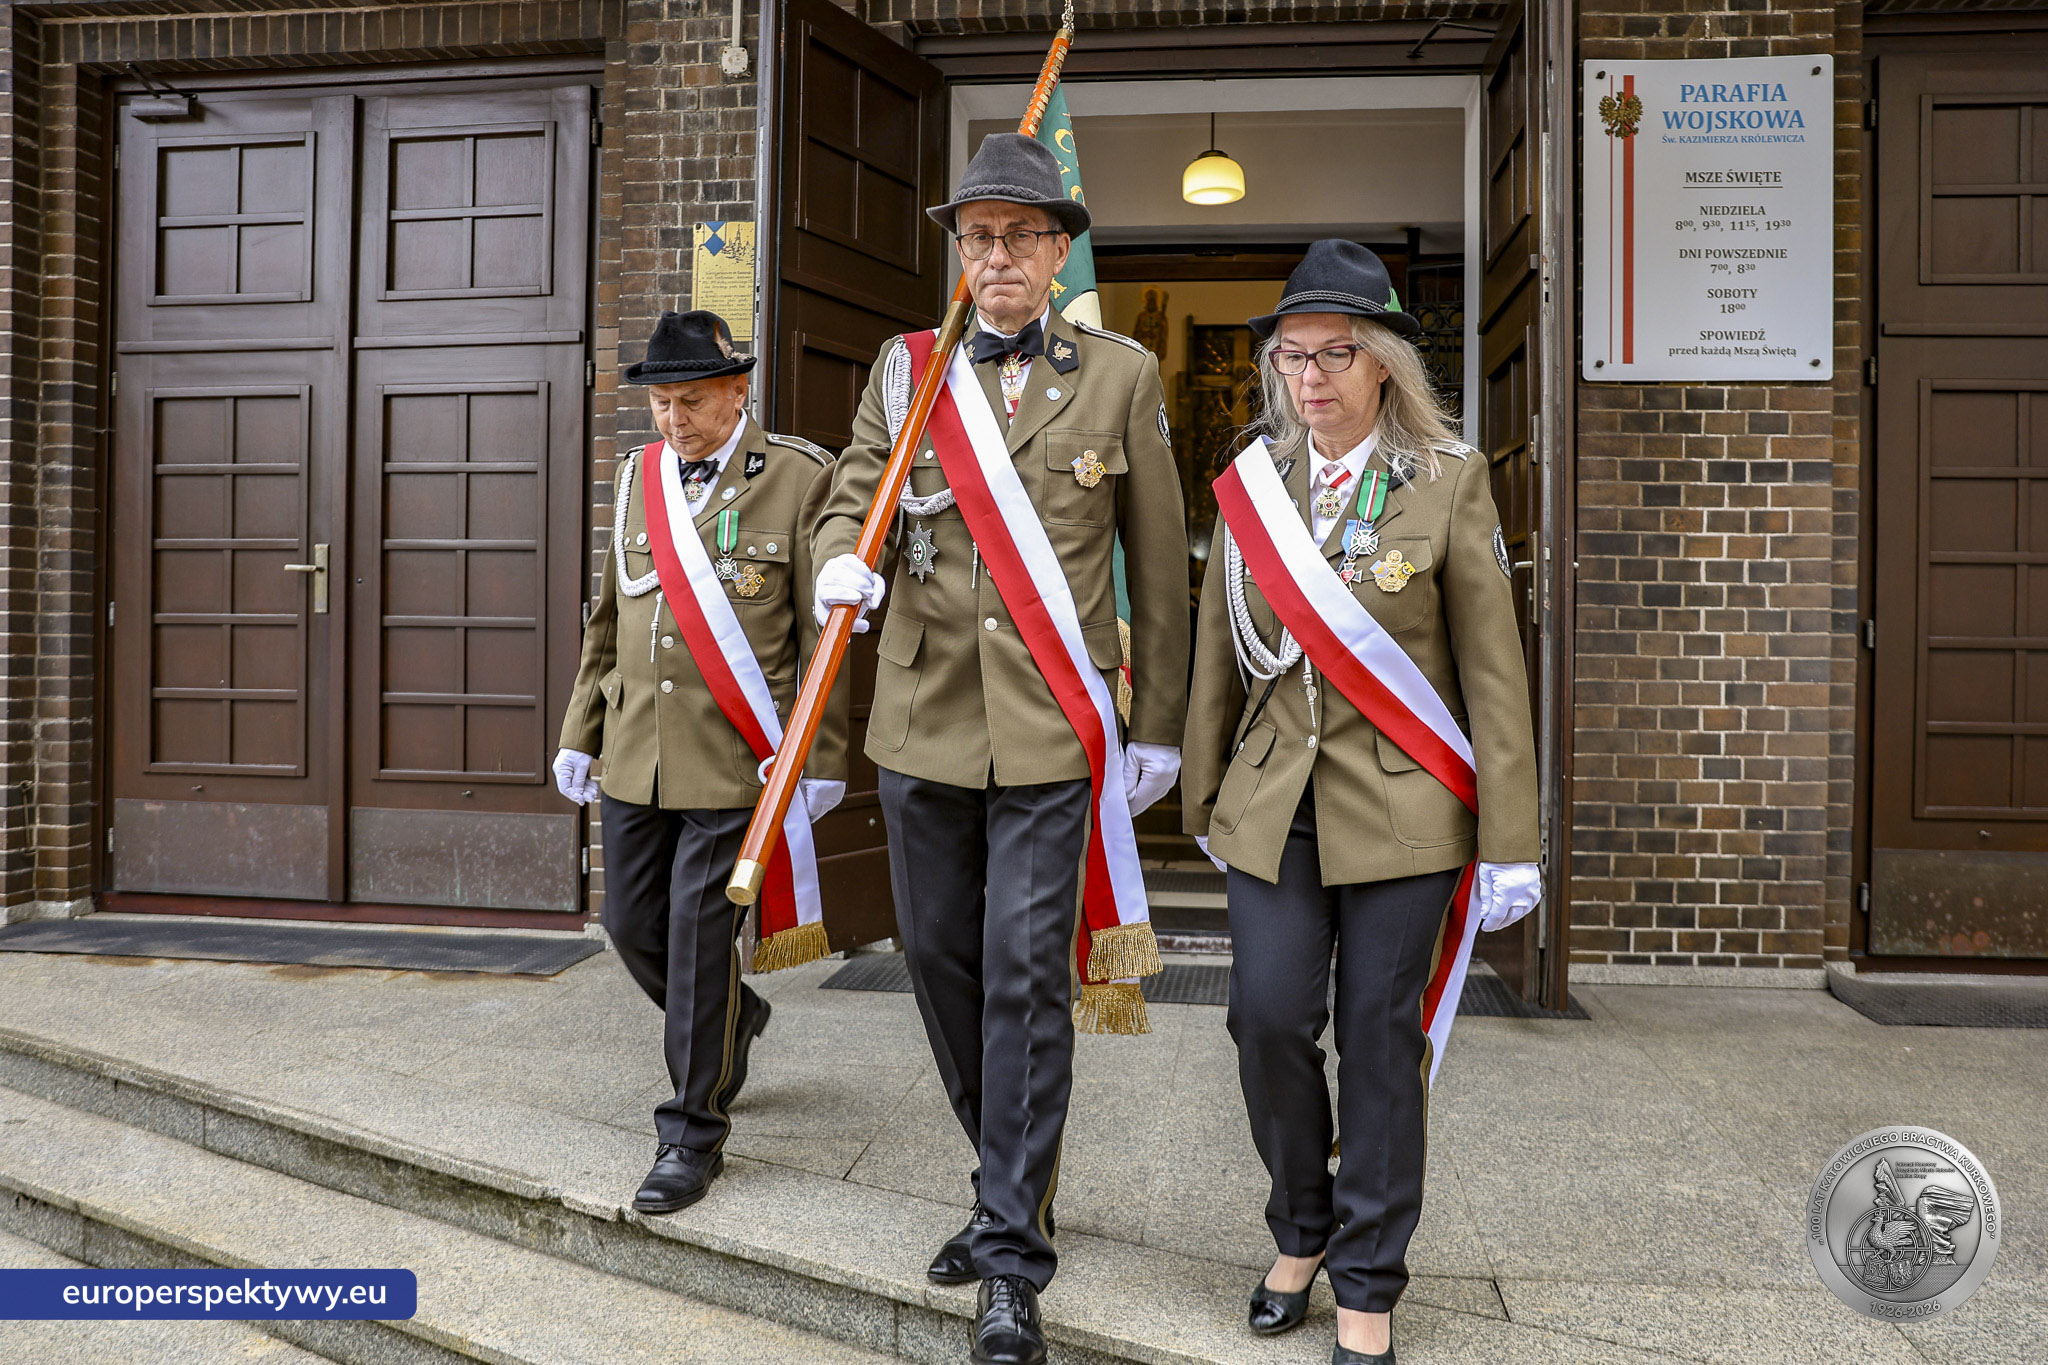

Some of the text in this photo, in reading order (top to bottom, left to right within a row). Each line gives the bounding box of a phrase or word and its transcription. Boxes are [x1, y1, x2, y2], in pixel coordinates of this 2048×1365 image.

[1680, 84, 1788, 103] PARAFIA
[1662, 110, 1805, 133] WOJSKOWA
[1661, 133, 1805, 144] Św. KAZIMIERZA KRÓLEWICZA
[1685, 169, 1782, 185] MSZE ŚWIĘTE
[1700, 205, 1766, 216] NIEDZIELA
[1679, 248, 1788, 259] DNI POWSZEDNIE
[1707, 288, 1758, 299] SOBOTY
[1699, 329, 1766, 341] SPOWIEDŹ
[1669, 345, 1797, 357] przed każdą Mszą Świętą
